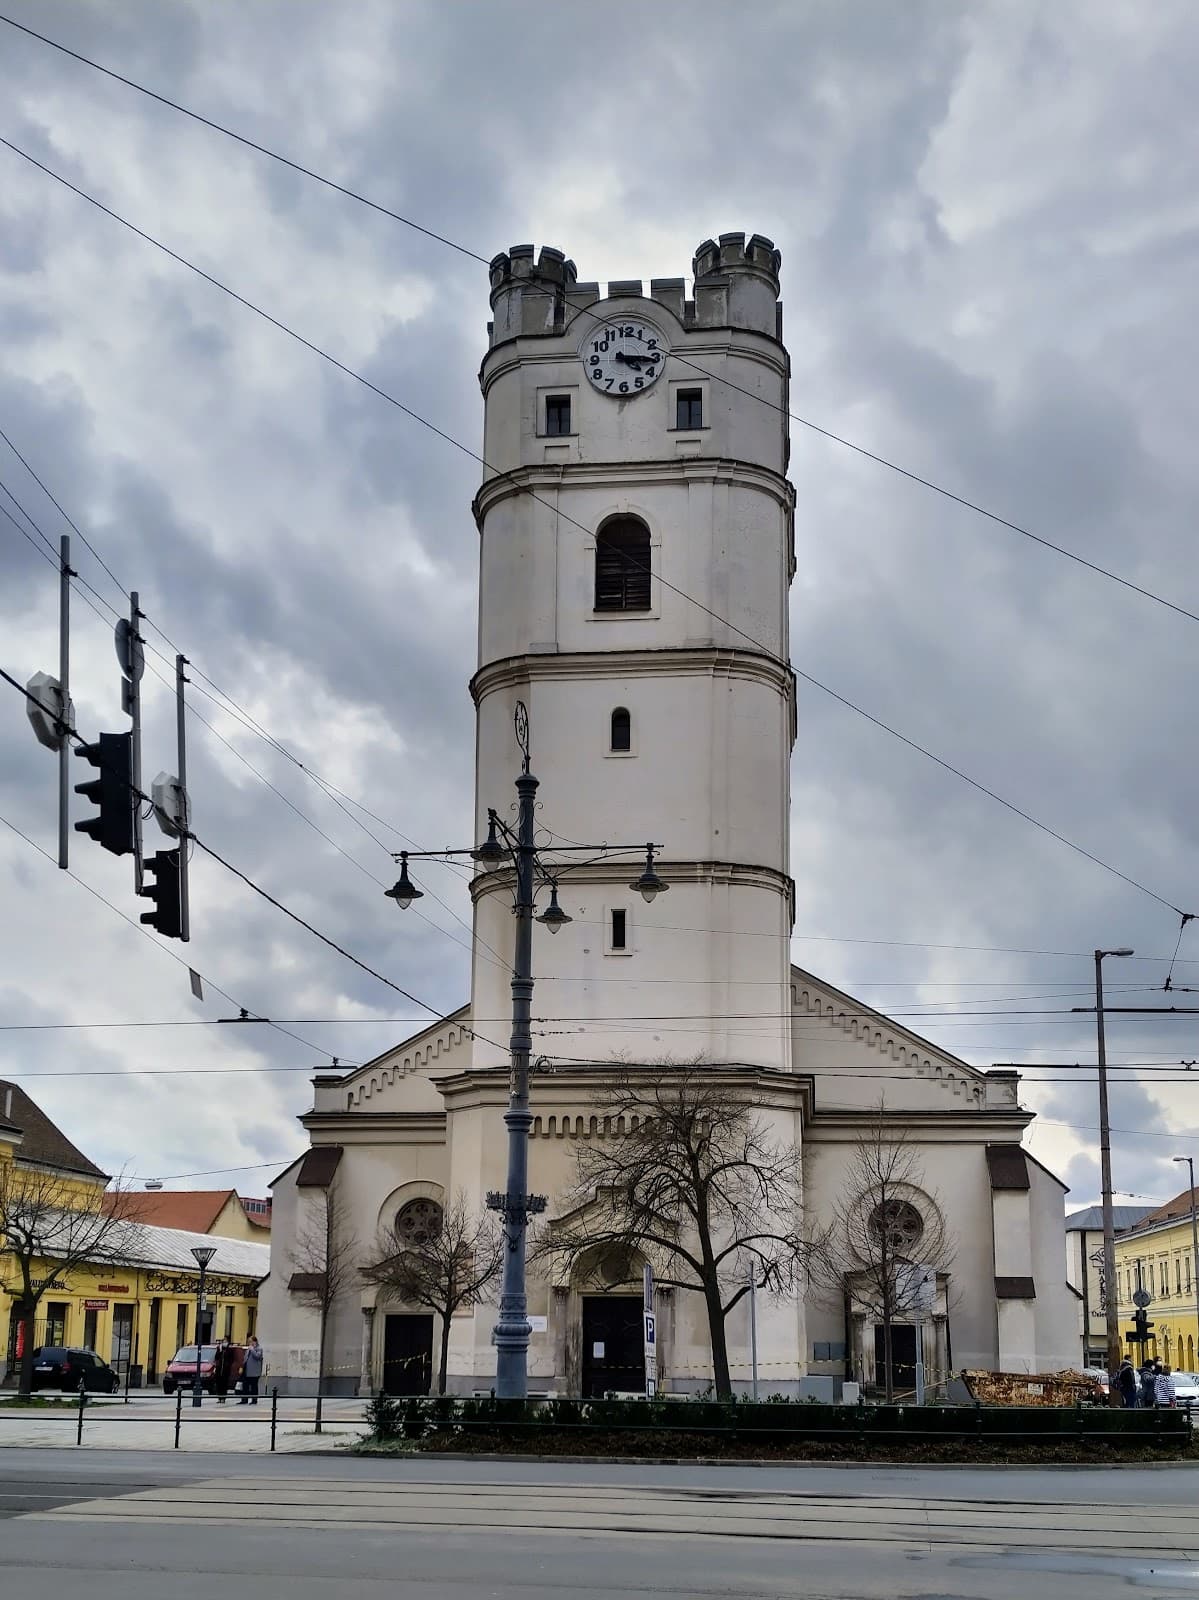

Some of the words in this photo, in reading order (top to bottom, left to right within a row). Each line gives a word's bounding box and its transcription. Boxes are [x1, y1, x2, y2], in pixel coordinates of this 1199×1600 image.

[605, 330, 616, 341] 11
[618, 326, 634, 338] 12
[637, 329, 643, 340] 1
[594, 341, 609, 352] 10
[647, 339, 657, 350] 2
[590, 355, 600, 366] 9
[651, 352, 660, 363] 3
[593, 369, 603, 380] 8
[645, 366, 655, 377] 4
[605, 378, 614, 389] 7
[619, 381, 629, 392] 6
[634, 377, 644, 388] 5
[647, 1319, 653, 1341] P
